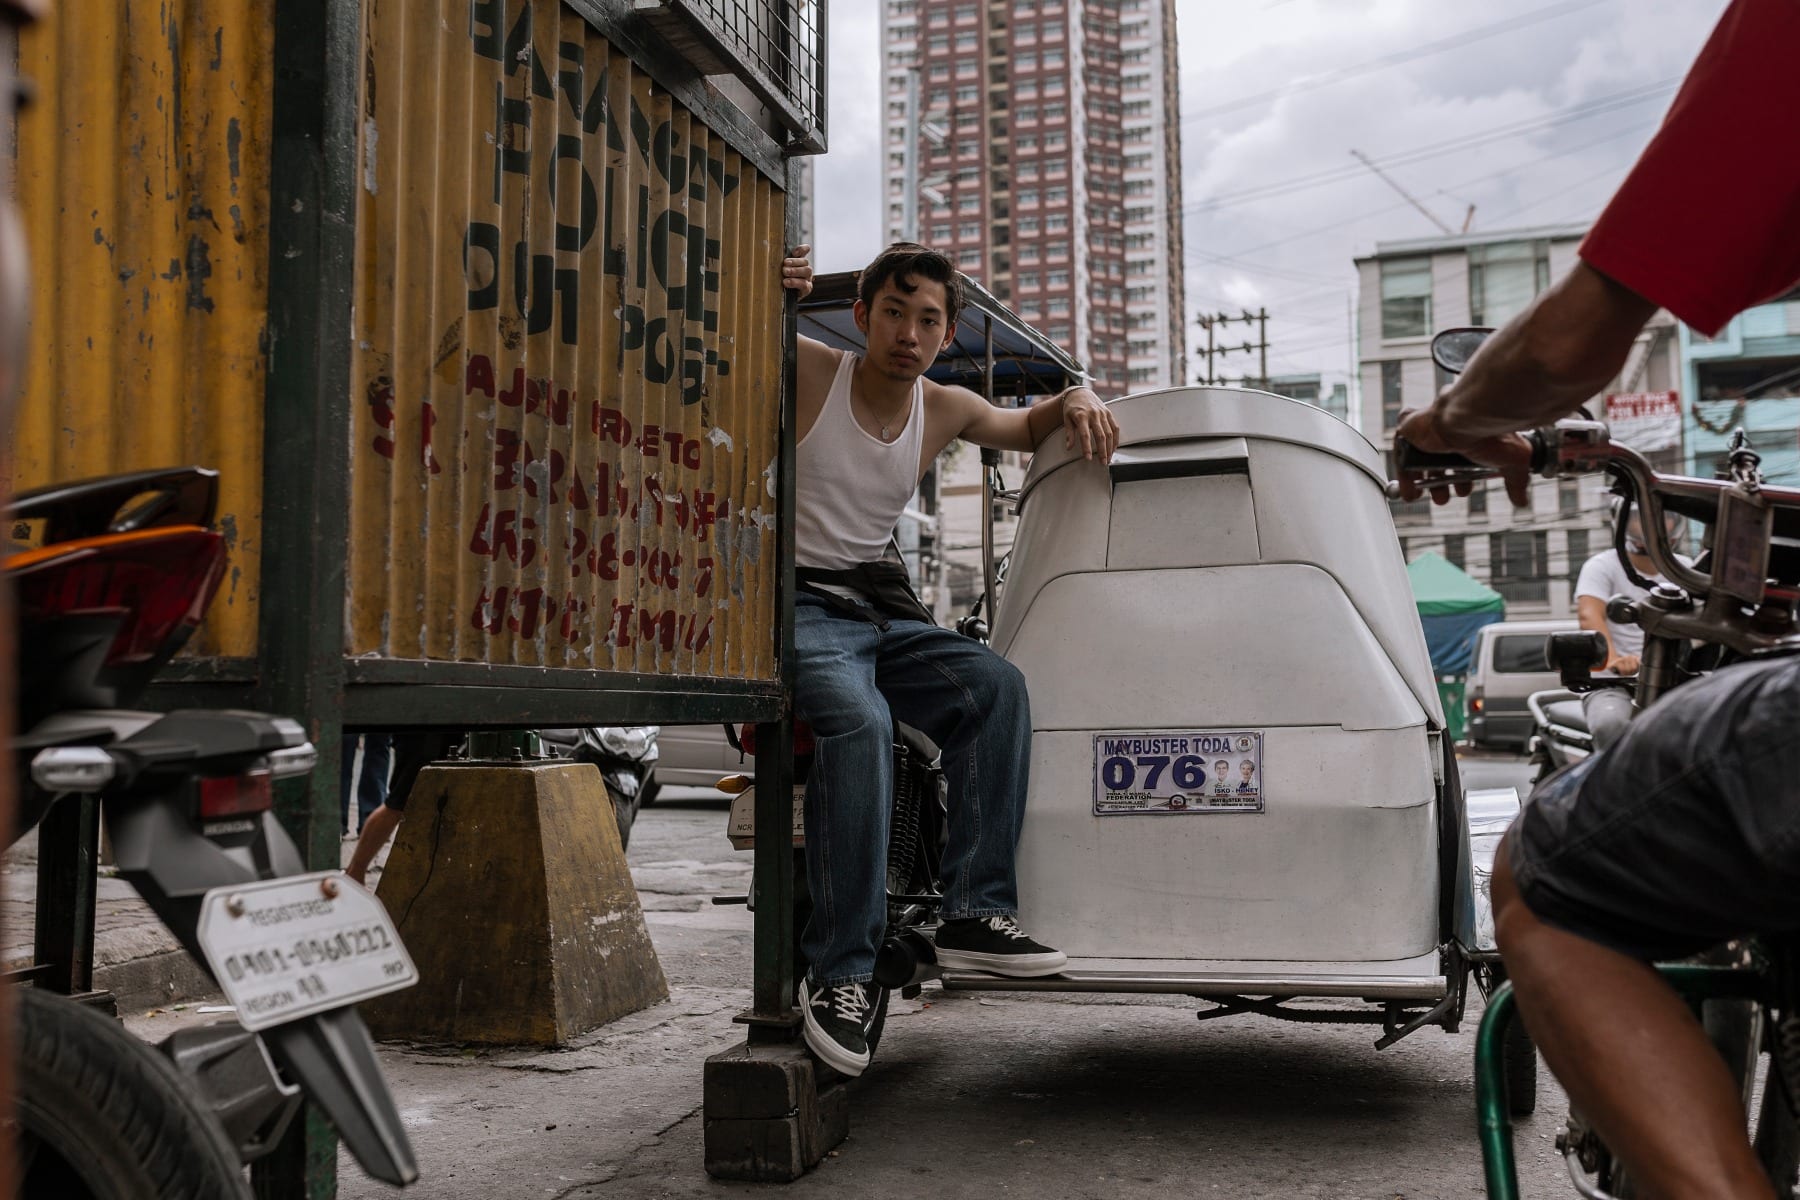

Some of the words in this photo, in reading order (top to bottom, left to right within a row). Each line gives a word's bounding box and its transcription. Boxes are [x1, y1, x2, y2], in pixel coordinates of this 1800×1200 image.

[494, 80, 720, 332] POLICE
[463, 222, 577, 346] OUT
[1104, 738, 1190, 755] MAYBUSTER
[1193, 738, 1232, 753] TODA
[1102, 755, 1207, 790] 076
[737, 823, 753, 831] NCR
